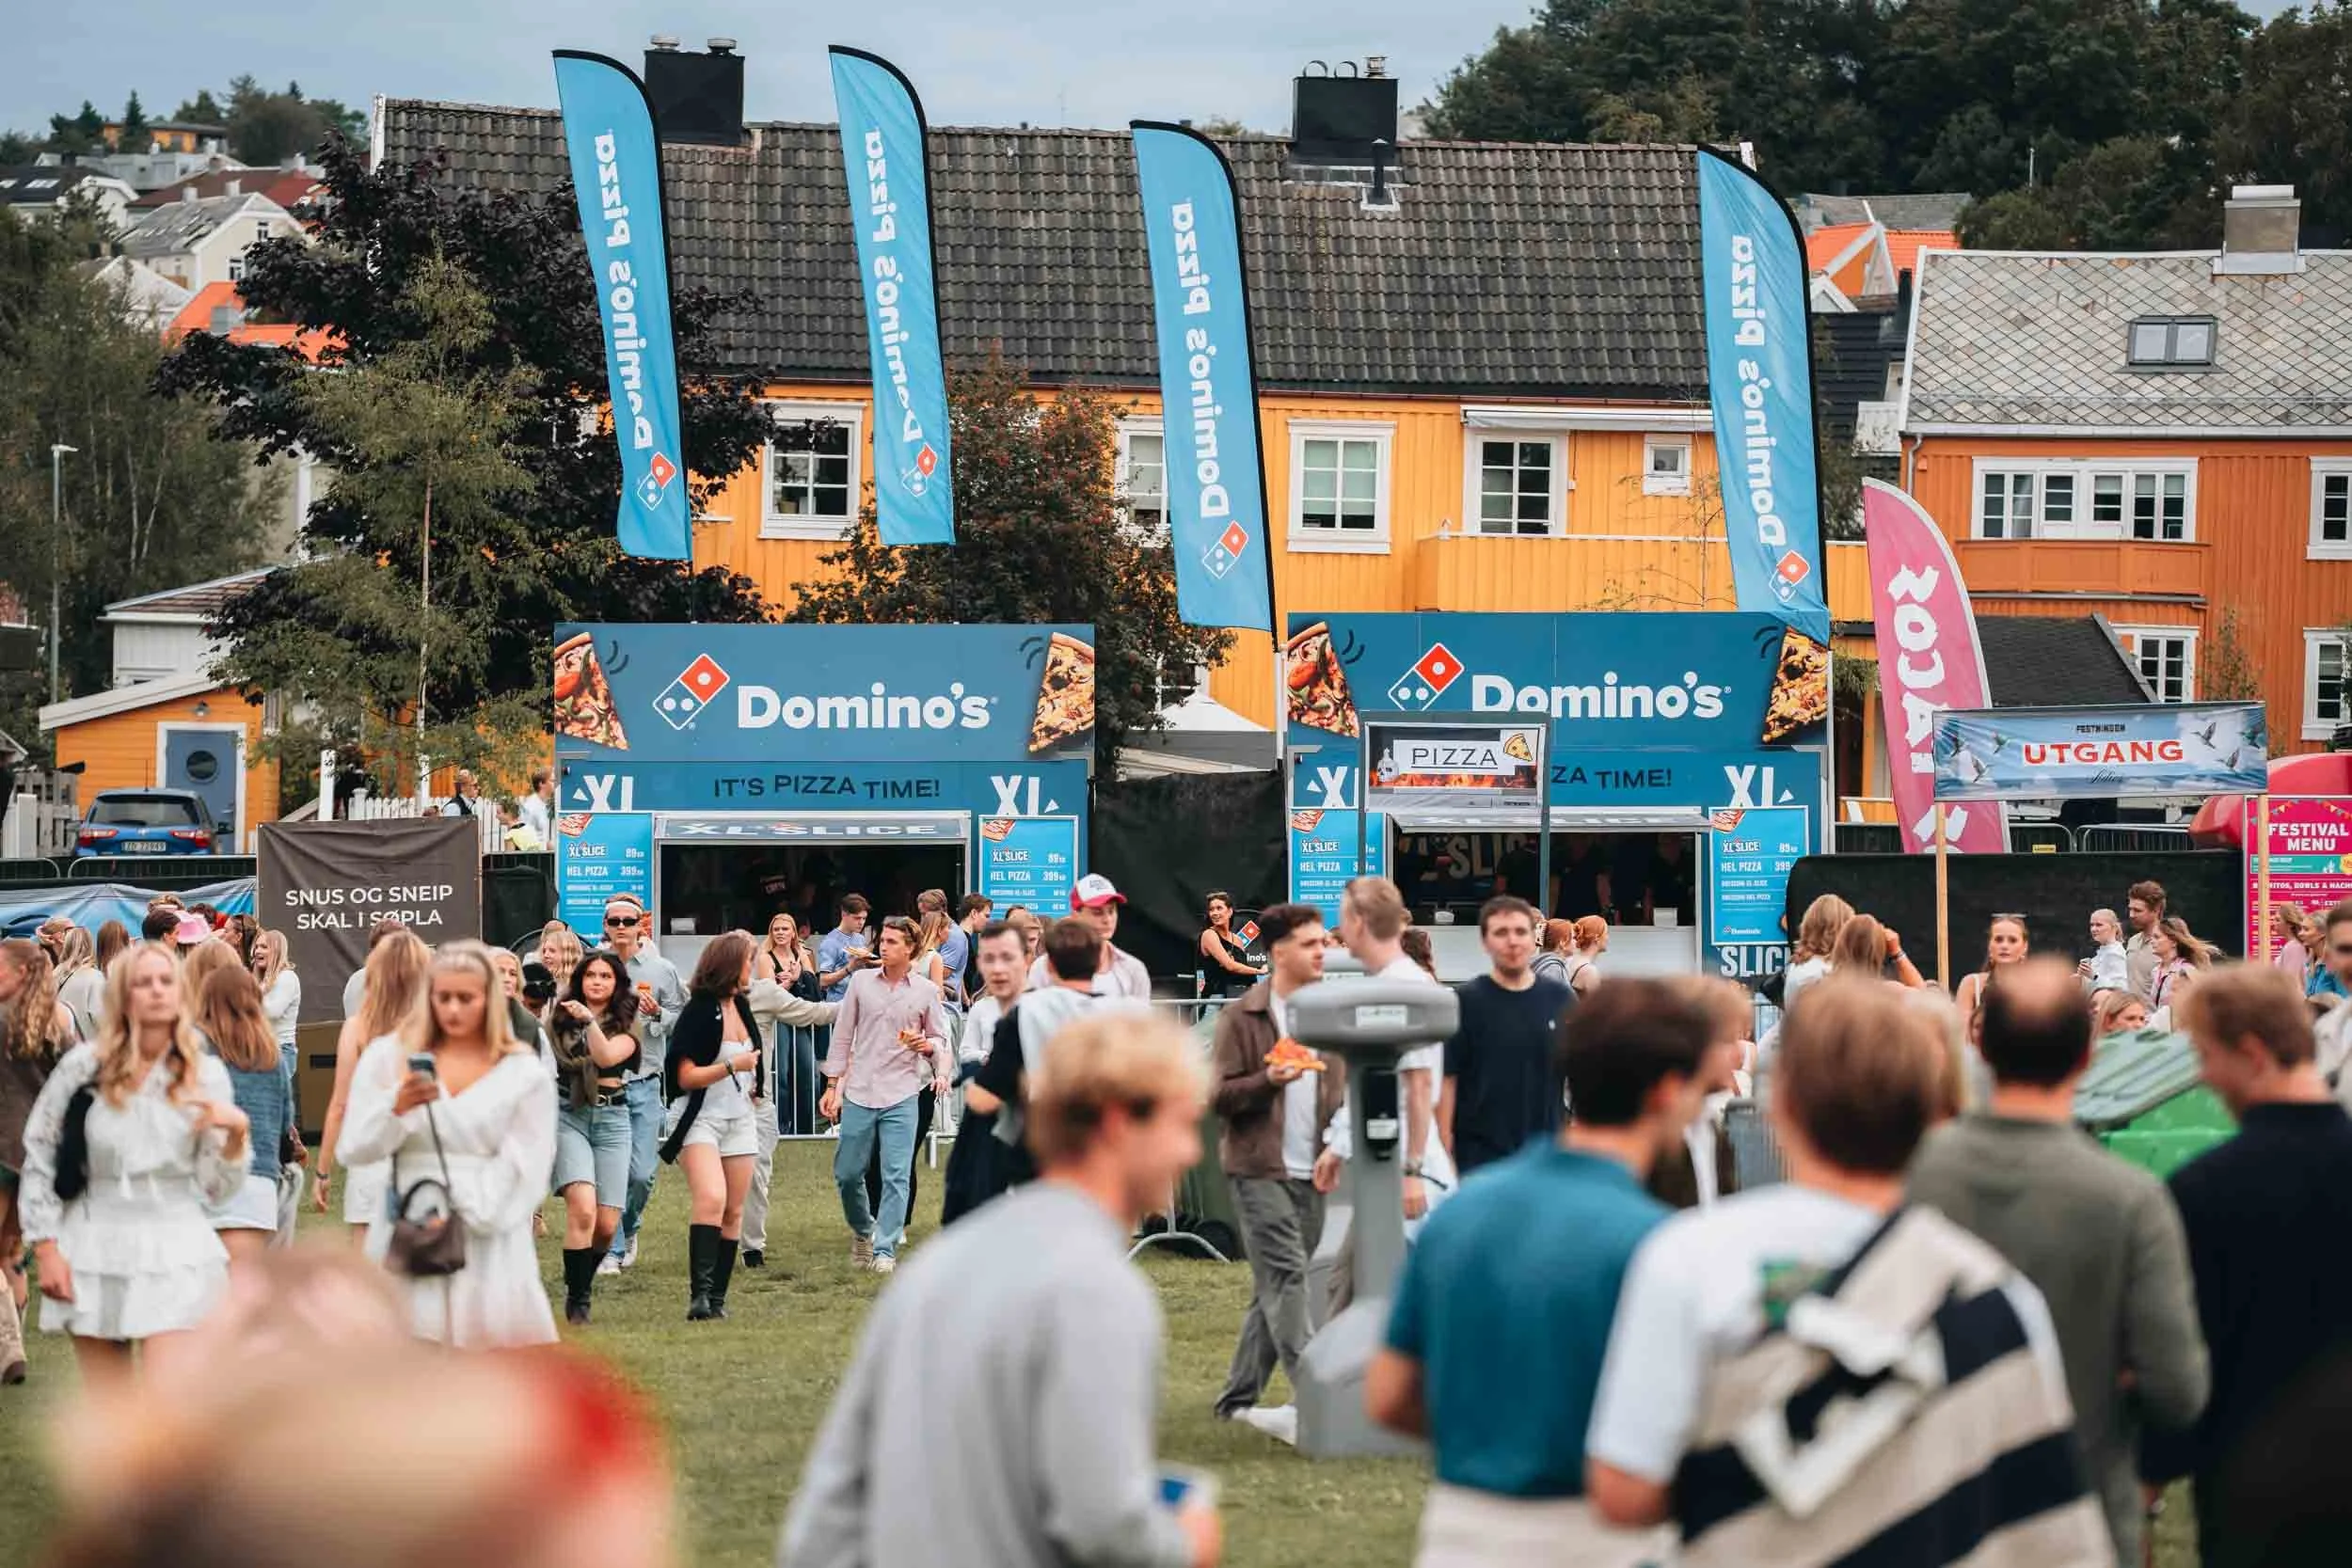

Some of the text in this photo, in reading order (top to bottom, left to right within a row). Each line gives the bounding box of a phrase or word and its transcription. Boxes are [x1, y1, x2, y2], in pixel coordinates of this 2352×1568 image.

[1472, 672, 1724, 719] Domino's
[738, 683, 991, 729] Domino's
[1411, 748, 1499, 767] PIZZA
[2024, 740, 2184, 765] UTGANG
[714, 774, 940, 800] IT'S PIZZA TIME!
[1594, 768, 1672, 789] TIME!
[2268, 823, 2349, 836] FESTIVAL
[2287, 838, 2336, 851] MENU
[585, 865, 609, 877] PIZZA
[1009, 871, 1031, 881] PIZZA
[1318, 862, 1341, 872] PIZZA
[1721, 862, 1737, 872] HEL
[1739, 861, 1762, 871] PIZZA
[285, 885, 453, 906] SNUS OG SNEIP
[296, 911, 353, 929] SKAL
[358, 911, 363, 927] I
[1720, 946, 1790, 977] SLIC
